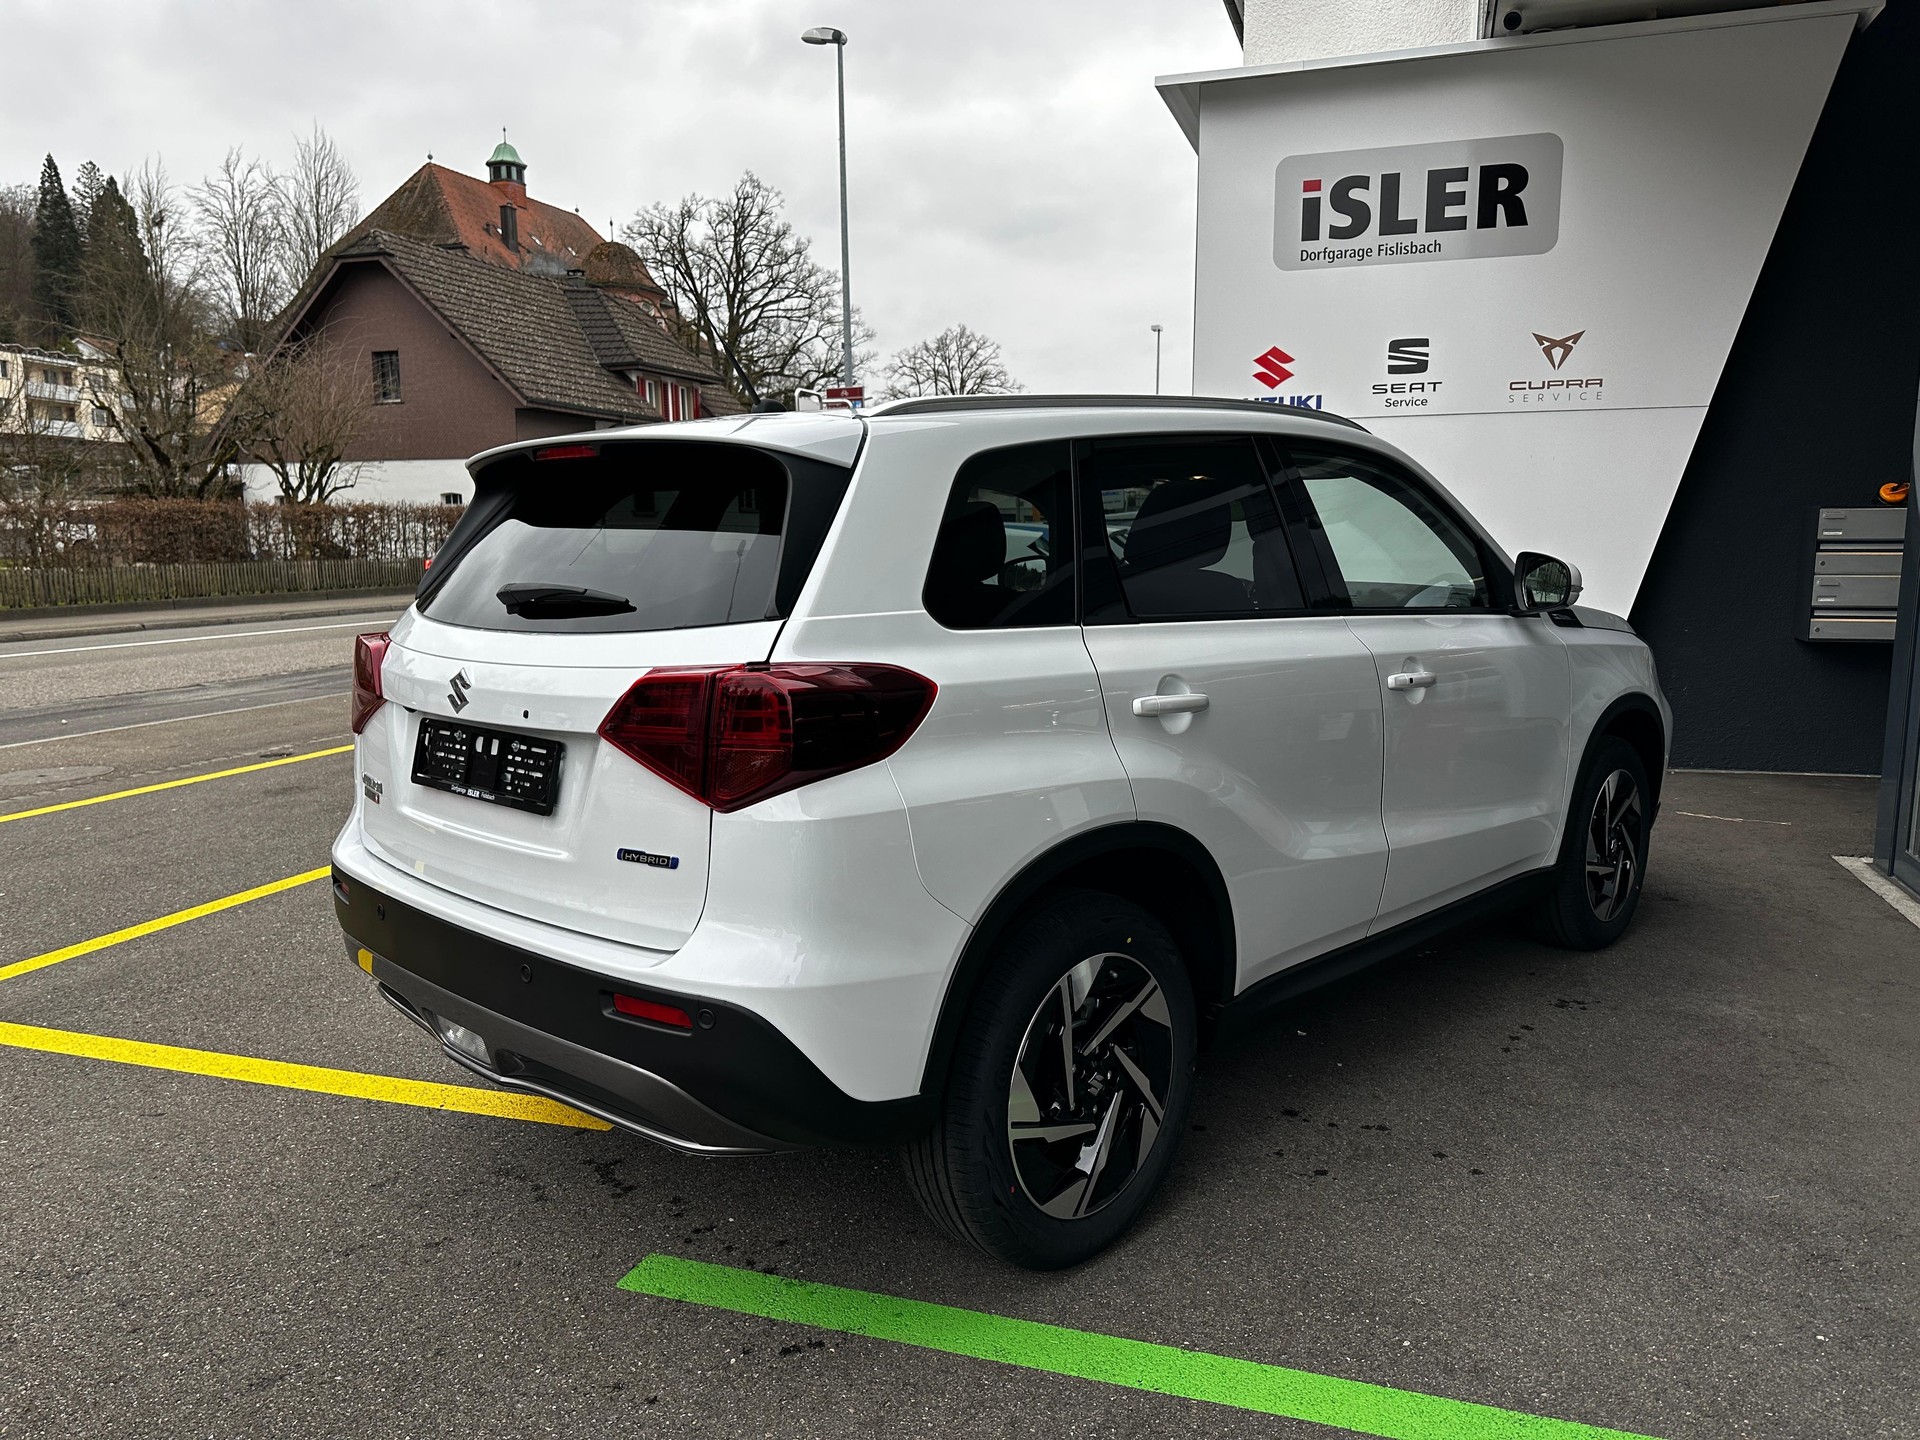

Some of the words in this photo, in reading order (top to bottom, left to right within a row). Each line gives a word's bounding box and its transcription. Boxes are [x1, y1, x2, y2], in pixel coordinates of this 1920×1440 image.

[1300, 247, 1373, 263] Dorfgarage
[1377, 239, 1442, 257] Fislisbach
[1372, 381, 1443, 395] SEAT
[1509, 378, 1603, 391] CUPRA
[1384, 396, 1428, 408] Service
[1508, 391, 1603, 403] SERVICE
[624, 852, 668, 866] HYBRID
